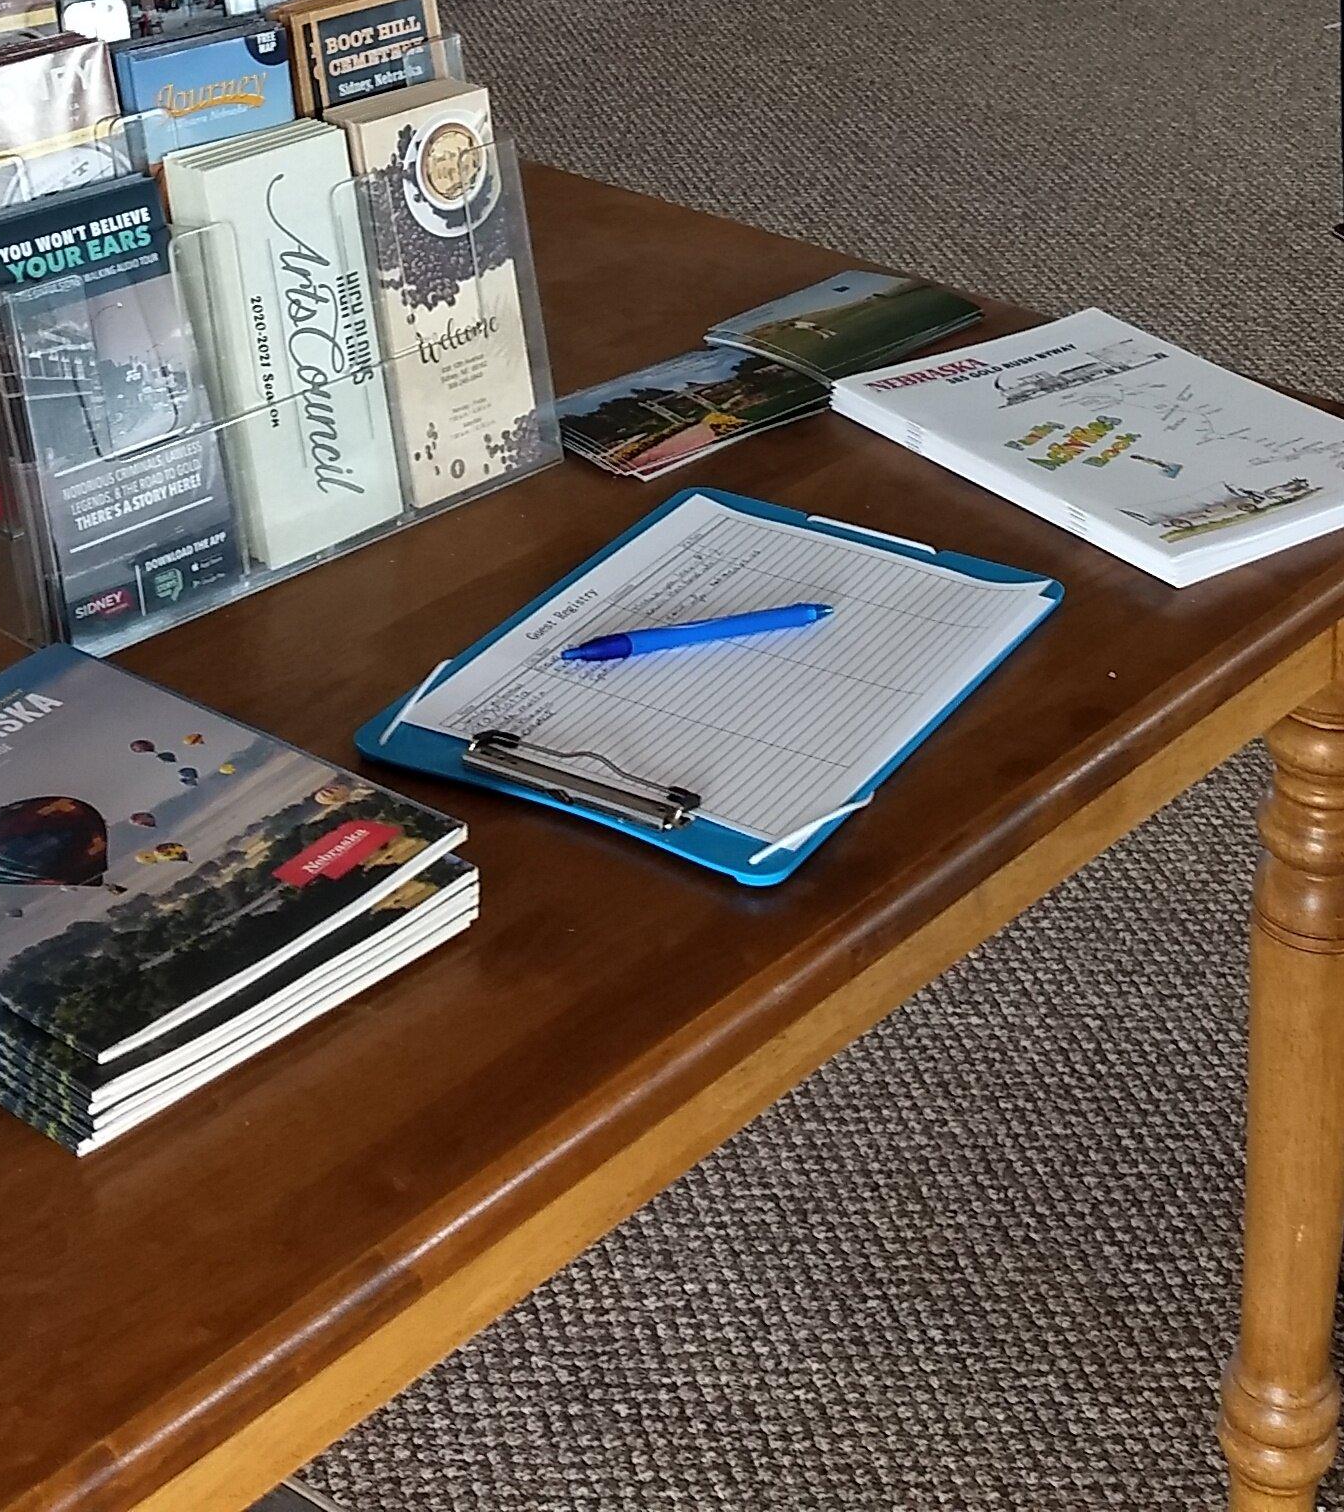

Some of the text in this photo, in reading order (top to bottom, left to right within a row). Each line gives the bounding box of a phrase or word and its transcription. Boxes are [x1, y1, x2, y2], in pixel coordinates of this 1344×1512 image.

[326, 16, 421, 55] BOOT HILL
[328, 37, 425, 77] CEMETERY
[338, 64, 424, 97] Sidney, Nebraska
[34, 225, 87, 254] WON'T
[89, 207, 152, 238] BELIEVE
[6, 225, 153, 284] YOUR EARS
[83, 264, 117, 283] WALKING
[250, 296, 271, 368] 2020-2021
[418, 316, 500, 364] Welcome
[863, 358, 989, 392] NEBRASKA
[968, 343, 1078, 381] GOLD RUSH BYWAY
[287, 283, 365, 494] Council
[62, 440, 202, 501] NOTORIOUS LAWLESS
[139, 470, 164, 490] ROAD
[75, 473, 202, 531] THERE'S A STORY HERE!
[145, 531, 227, 572] DOWNLOAD THE APP
[74, 590, 123, 620] SIDNEY
[525, 587, 599, 642] Guest Registry
[302, 828, 370, 875] Nebraska
